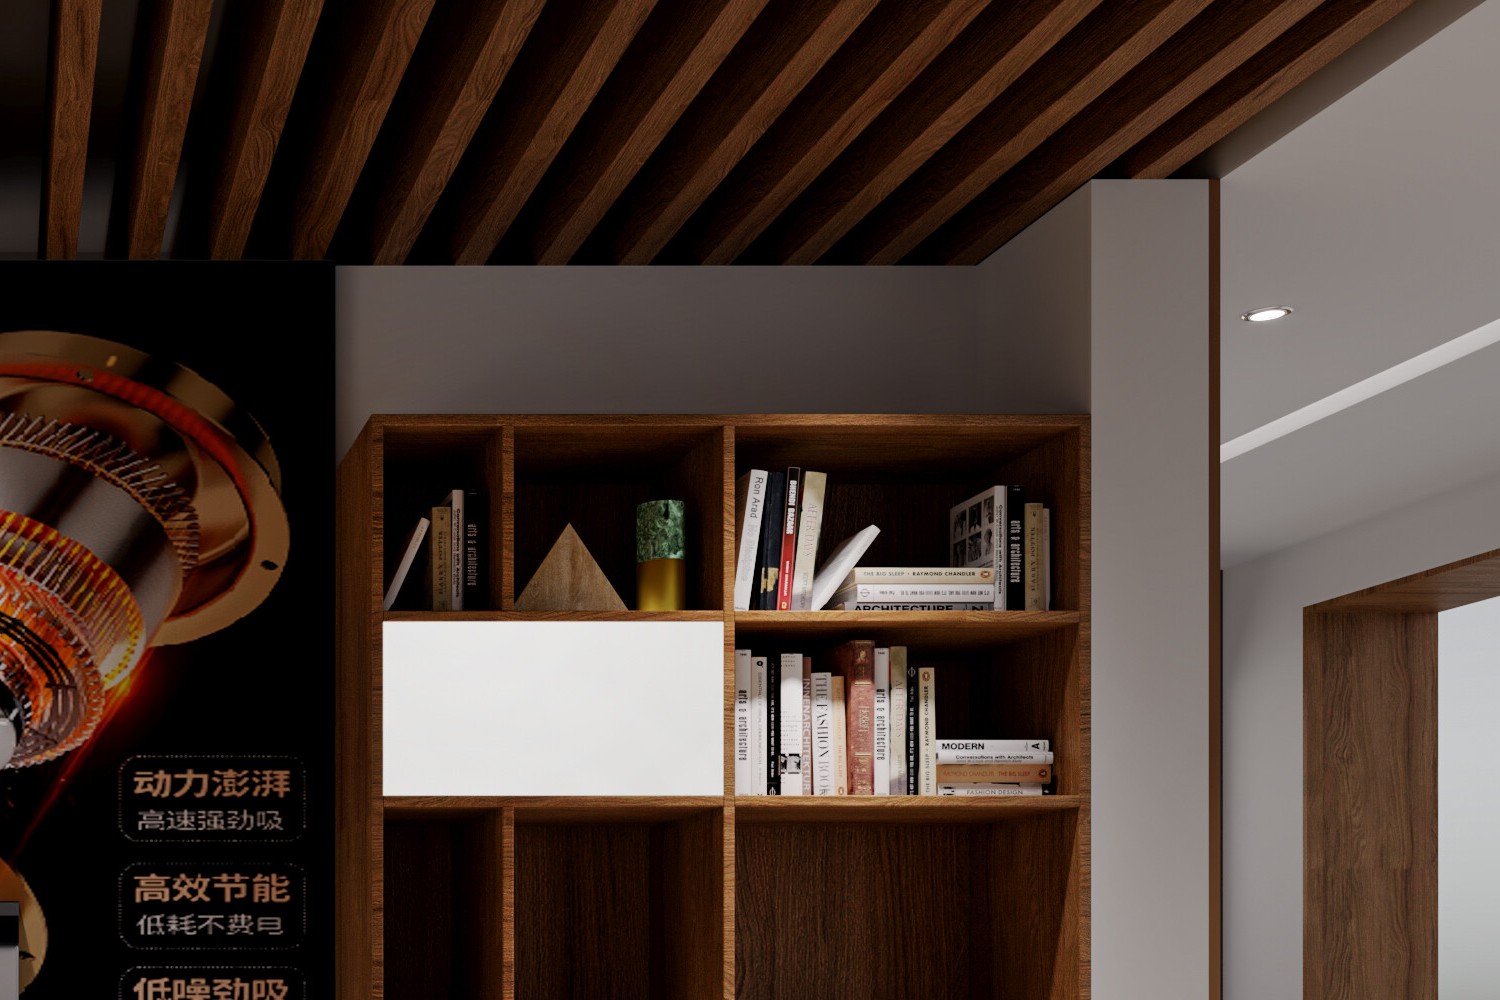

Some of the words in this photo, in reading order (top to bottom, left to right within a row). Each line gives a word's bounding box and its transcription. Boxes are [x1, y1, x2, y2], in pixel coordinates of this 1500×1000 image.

[753, 476, 763, 495] Ron
[788, 480, 797, 506] BHENDI
[750, 498, 761, 518] Arad
[786, 507, 796, 534] BAZAAR
[806, 503, 818, 533] AFTER
[467, 524, 478, 537] arts
[1010, 520, 1022, 533] arts
[803, 534, 815, 558] DAYS
[467, 547, 478, 586] architecture
[1010, 543, 1022, 583] architecture
[738, 690, 748, 704] arts
[815, 674, 827, 700] THE
[876, 688, 887, 703] arts
[895, 680, 904, 713] AFTER
[738, 716, 748, 761] architecture
[802, 678, 811, 791] INNENARCHITEKTUR
[816, 704, 829, 758] FASHION
[876, 716, 887, 760] architecture
[895, 714, 904, 738] DAYS
[133, 769, 291, 798] 动力澎湃
[817, 761, 830, 796] BOOK
[137, 809, 284, 831] 高速强劲吸
[133, 873, 291, 903] 高效节能
[136, 914, 284, 935] 低耗不费电
